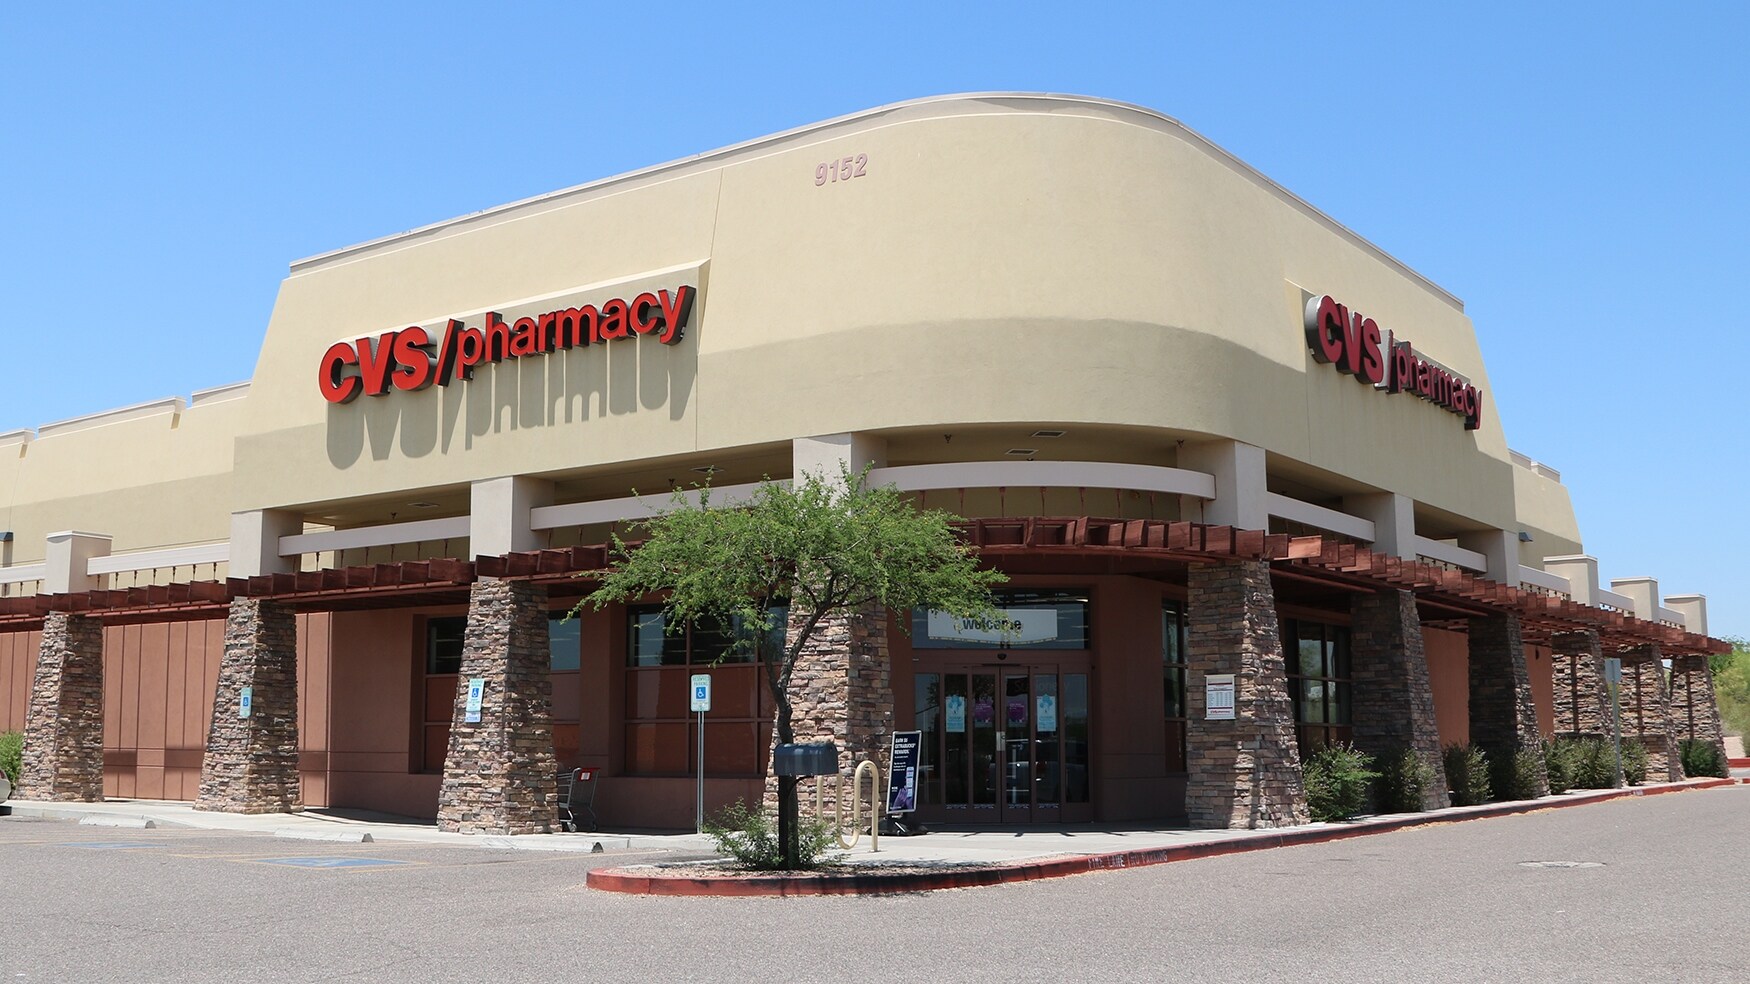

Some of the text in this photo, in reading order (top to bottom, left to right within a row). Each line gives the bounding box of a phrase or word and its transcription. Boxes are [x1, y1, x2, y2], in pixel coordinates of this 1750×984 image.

[815, 153, 868, 186] 9152
[318, 284, 696, 404] CVS/pharmacy
[1306, 294, 1483, 431] CVS/pharmacy
[1107, 854, 1126, 868] LANE
